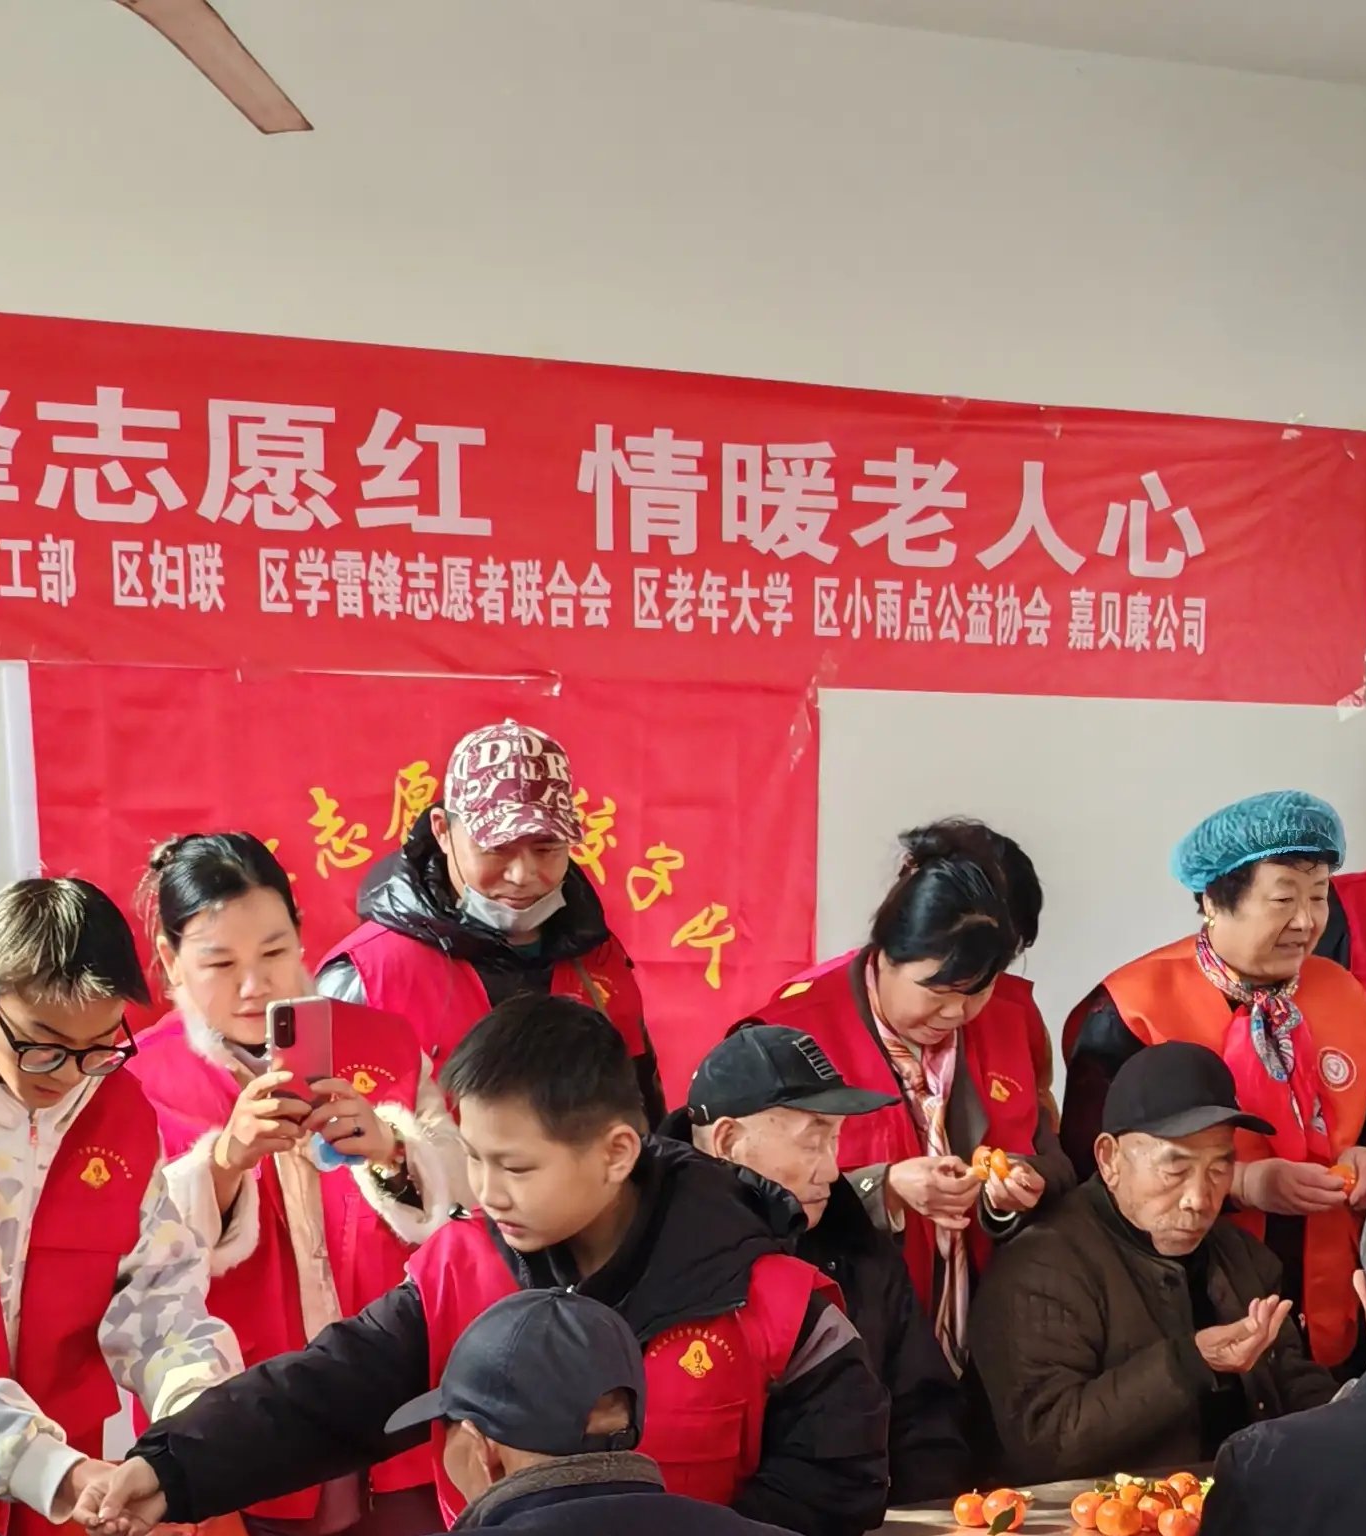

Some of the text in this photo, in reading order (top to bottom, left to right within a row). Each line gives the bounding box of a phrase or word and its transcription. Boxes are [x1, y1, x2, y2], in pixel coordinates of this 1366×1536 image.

[577, 422, 1206, 579] 情暖老人心
[110, 538, 226, 613] 区妇联
[258, 546, 612, 629] 区学雷锋志愿者联合会
[633, 566, 794, 637] 区老年大学
[813, 576, 1053, 647] 区小雨点公益协会
[1067, 586, 1207, 656] 嘉贝康公司
